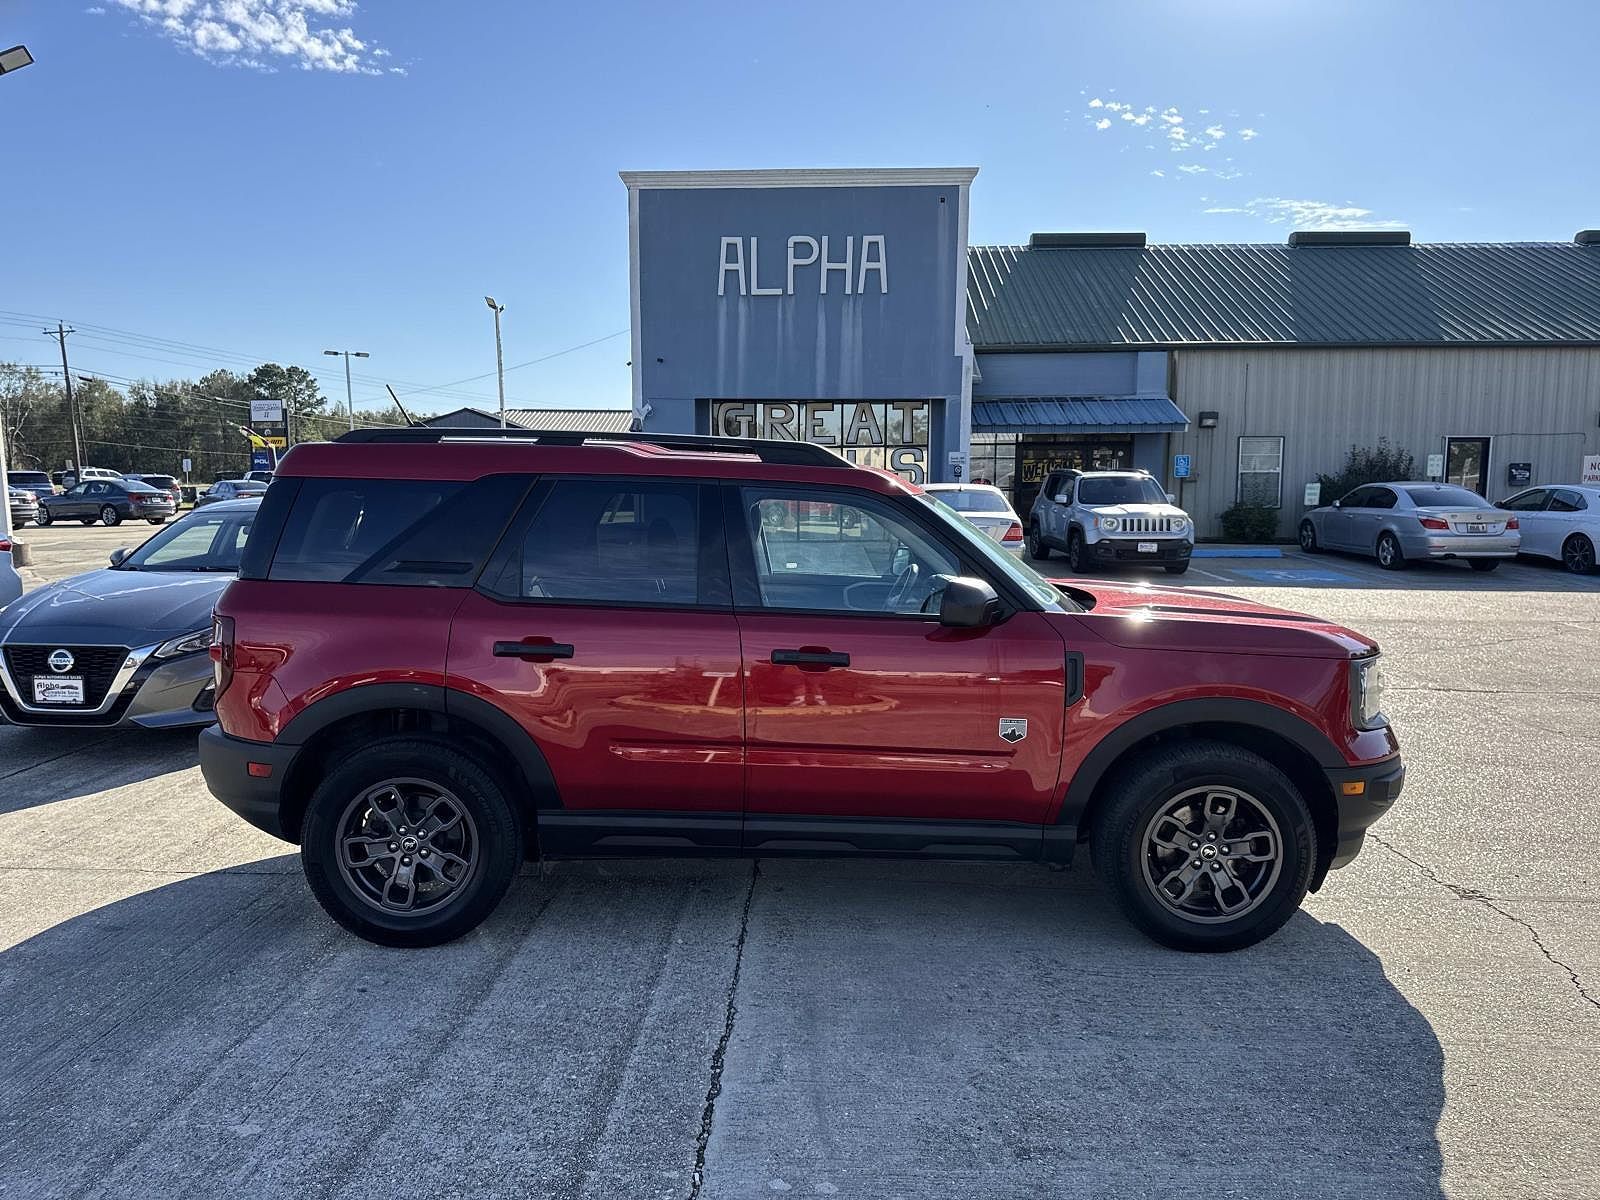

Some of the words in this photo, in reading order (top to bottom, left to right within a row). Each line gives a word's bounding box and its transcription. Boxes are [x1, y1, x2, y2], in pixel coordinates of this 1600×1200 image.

[717, 235, 888, 296] ALPHA
[717, 401, 925, 444] GREAT
[36, 682, 60, 690] Alpha
